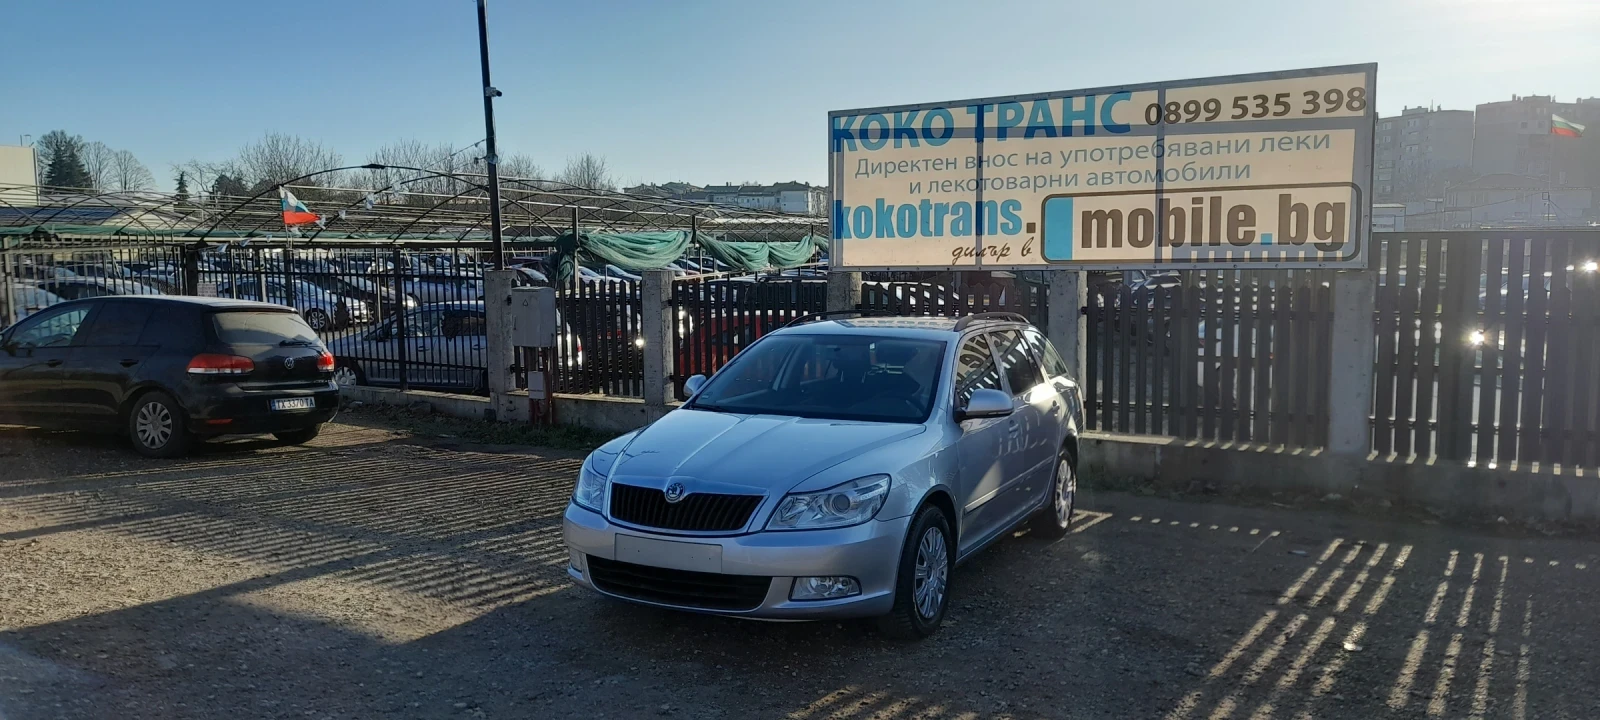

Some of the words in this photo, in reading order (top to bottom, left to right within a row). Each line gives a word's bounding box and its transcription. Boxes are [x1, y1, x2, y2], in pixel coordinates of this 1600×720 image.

[833, 107, 954, 152] КОКО
[966, 91, 1132, 143] ТРАНС
[1145, 98, 1222, 126] 0899
[1231, 93, 1291, 119] 535
[1302, 87, 1367, 114] 398
[855, 157, 957, 178] Директен
[965, 153, 1018, 170] внос
[1026, 151, 1052, 166] на
[1060, 138, 1250, 168] употребявани
[1259, 134, 1330, 152] леки
[909, 181, 921, 195] и
[927, 173, 1078, 193] лекотоварни
[1086, 162, 1250, 186] автомобили
[1081, 194, 1346, 252] mobile.bg
